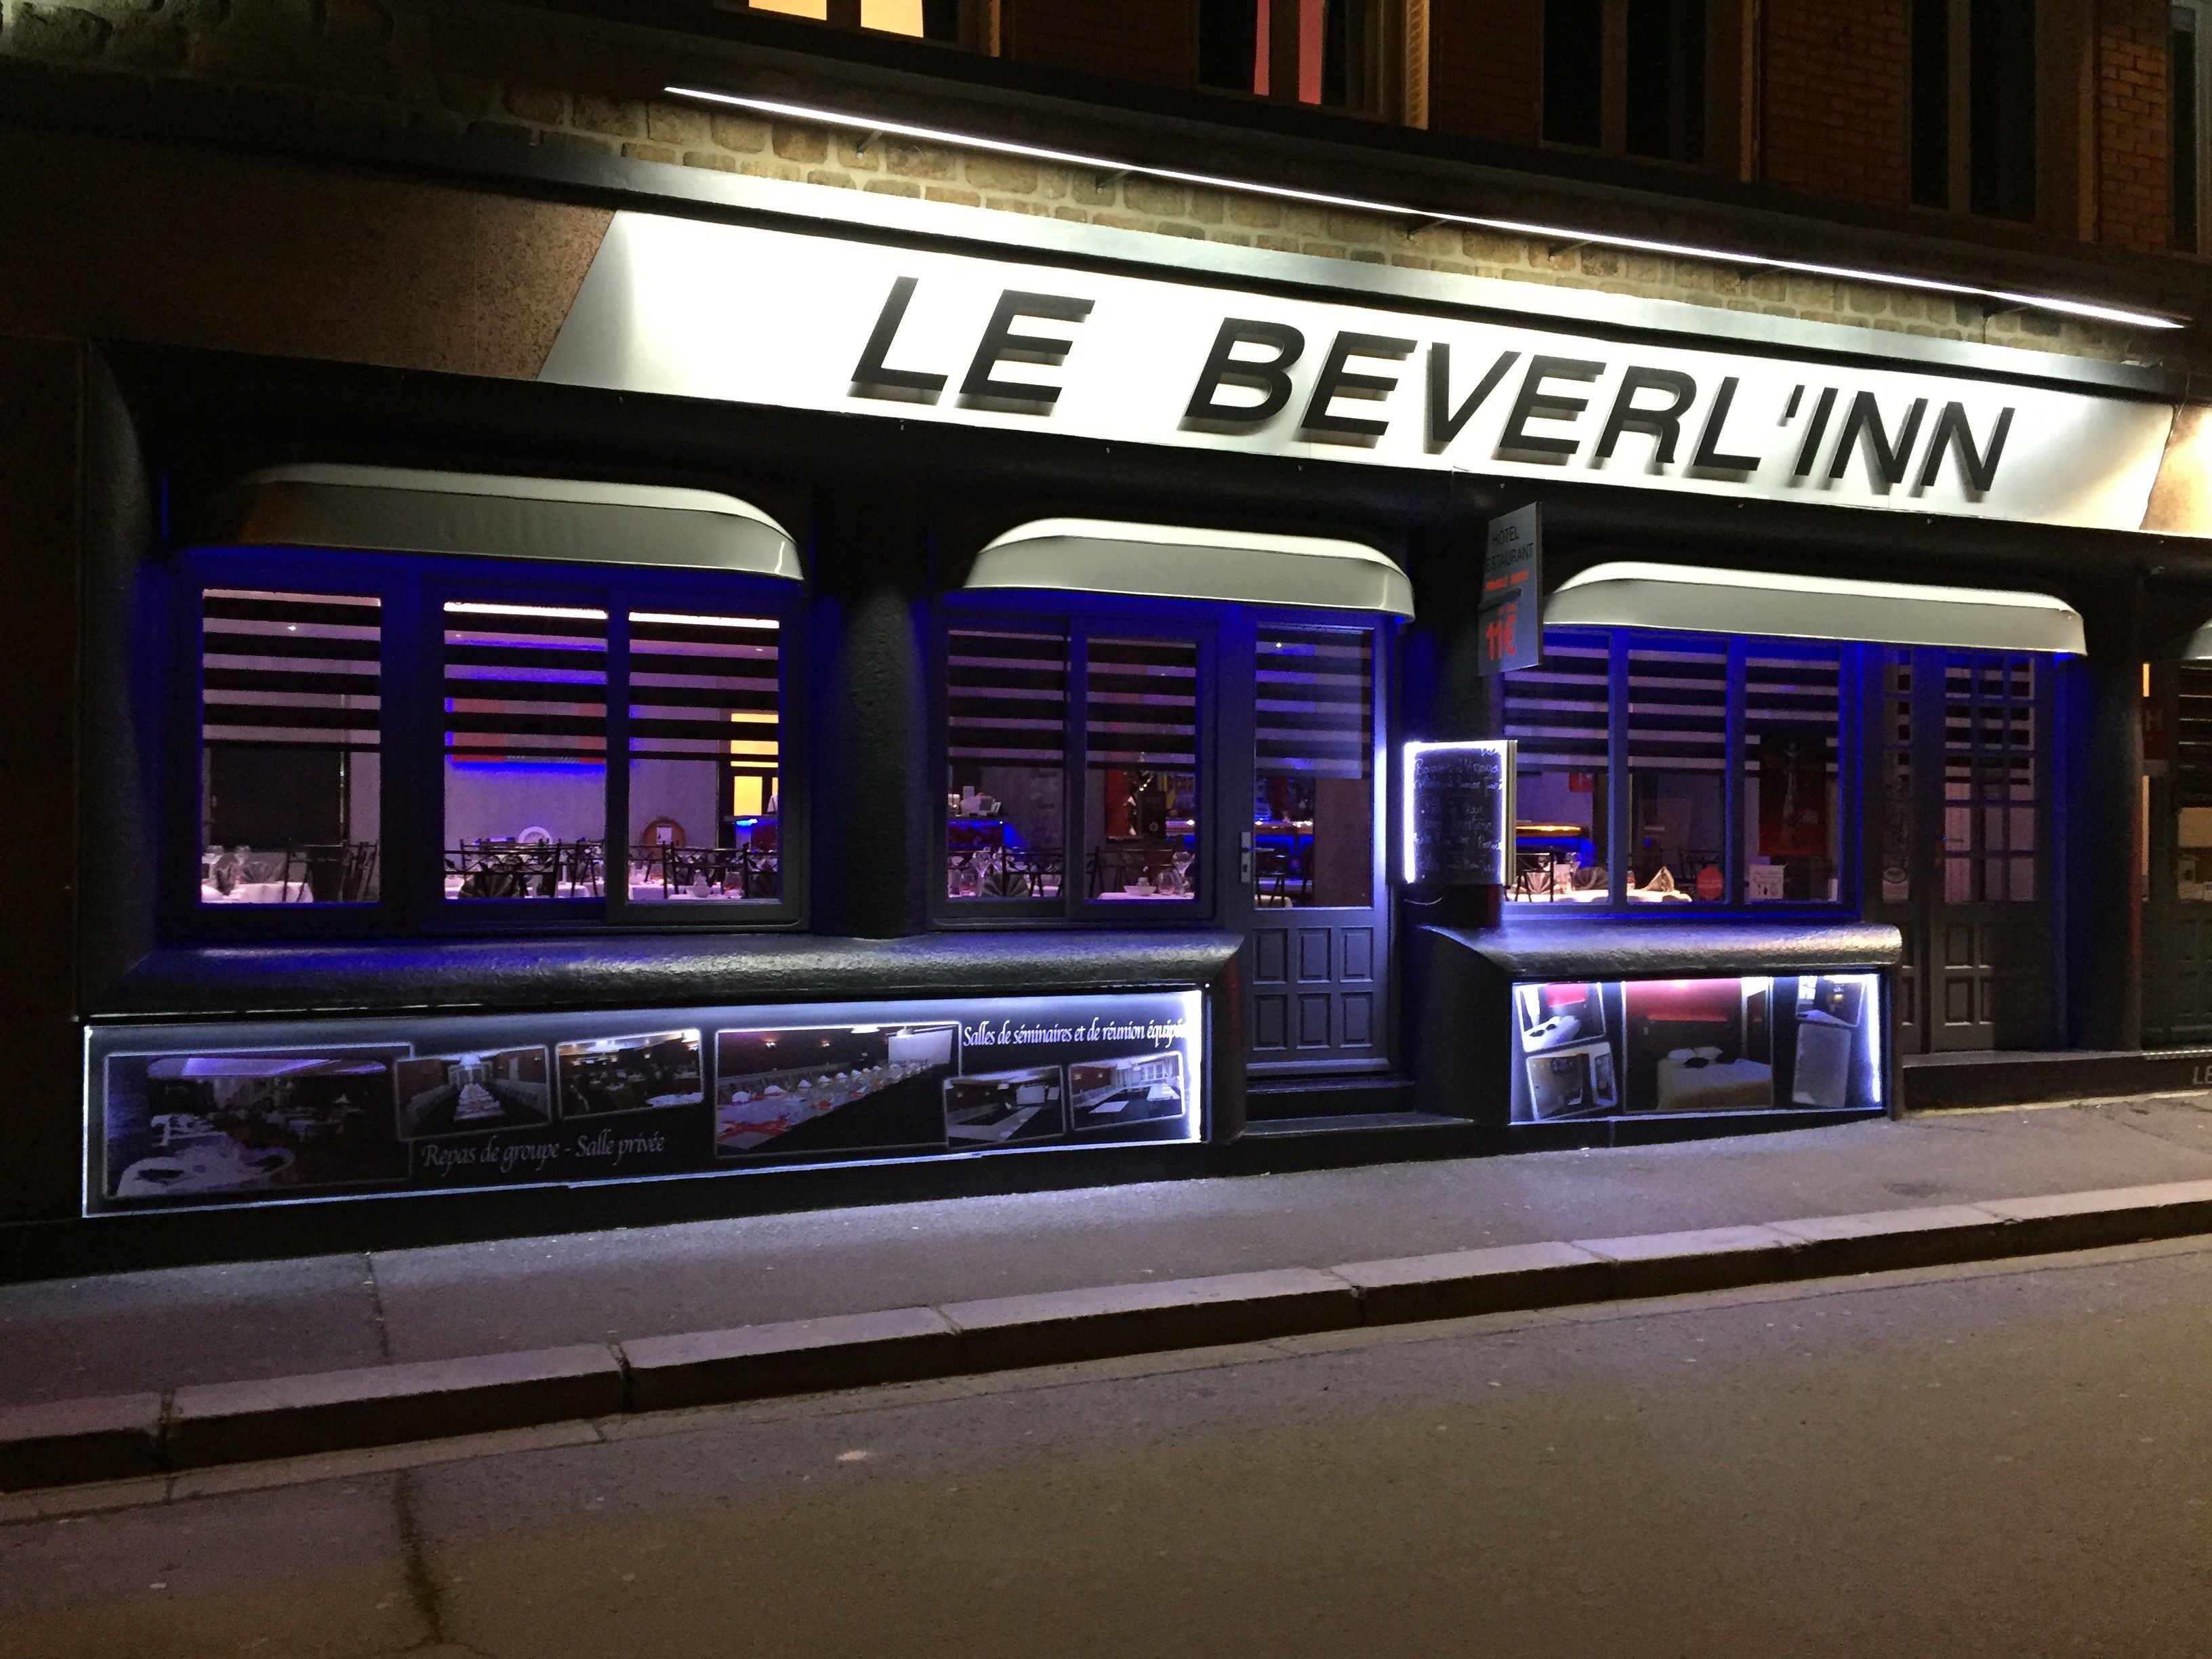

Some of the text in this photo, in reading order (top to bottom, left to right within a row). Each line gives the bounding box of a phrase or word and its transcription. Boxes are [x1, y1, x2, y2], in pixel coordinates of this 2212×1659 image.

[851, 275, 2015, 493] LE BEVERL'INN
[1484, 614, 1517, 661] 11€
[963, 1020, 996, 1046] Salles
[998, 1019, 1012, 1045] de
[1013, 1023, 1073, 1044] séminaires
[1074, 1025, 1086, 1042] et
[1087, 1017, 1101, 1042] de
[1102, 1021, 1145, 1040] réunion
[422, 1144, 476, 1177] Repas
[480, 1134, 501, 1163] de
[499, 1142, 559, 1174] groupe
[575, 1128, 613, 1157] Salle
[612, 1130, 666, 1166] privée
